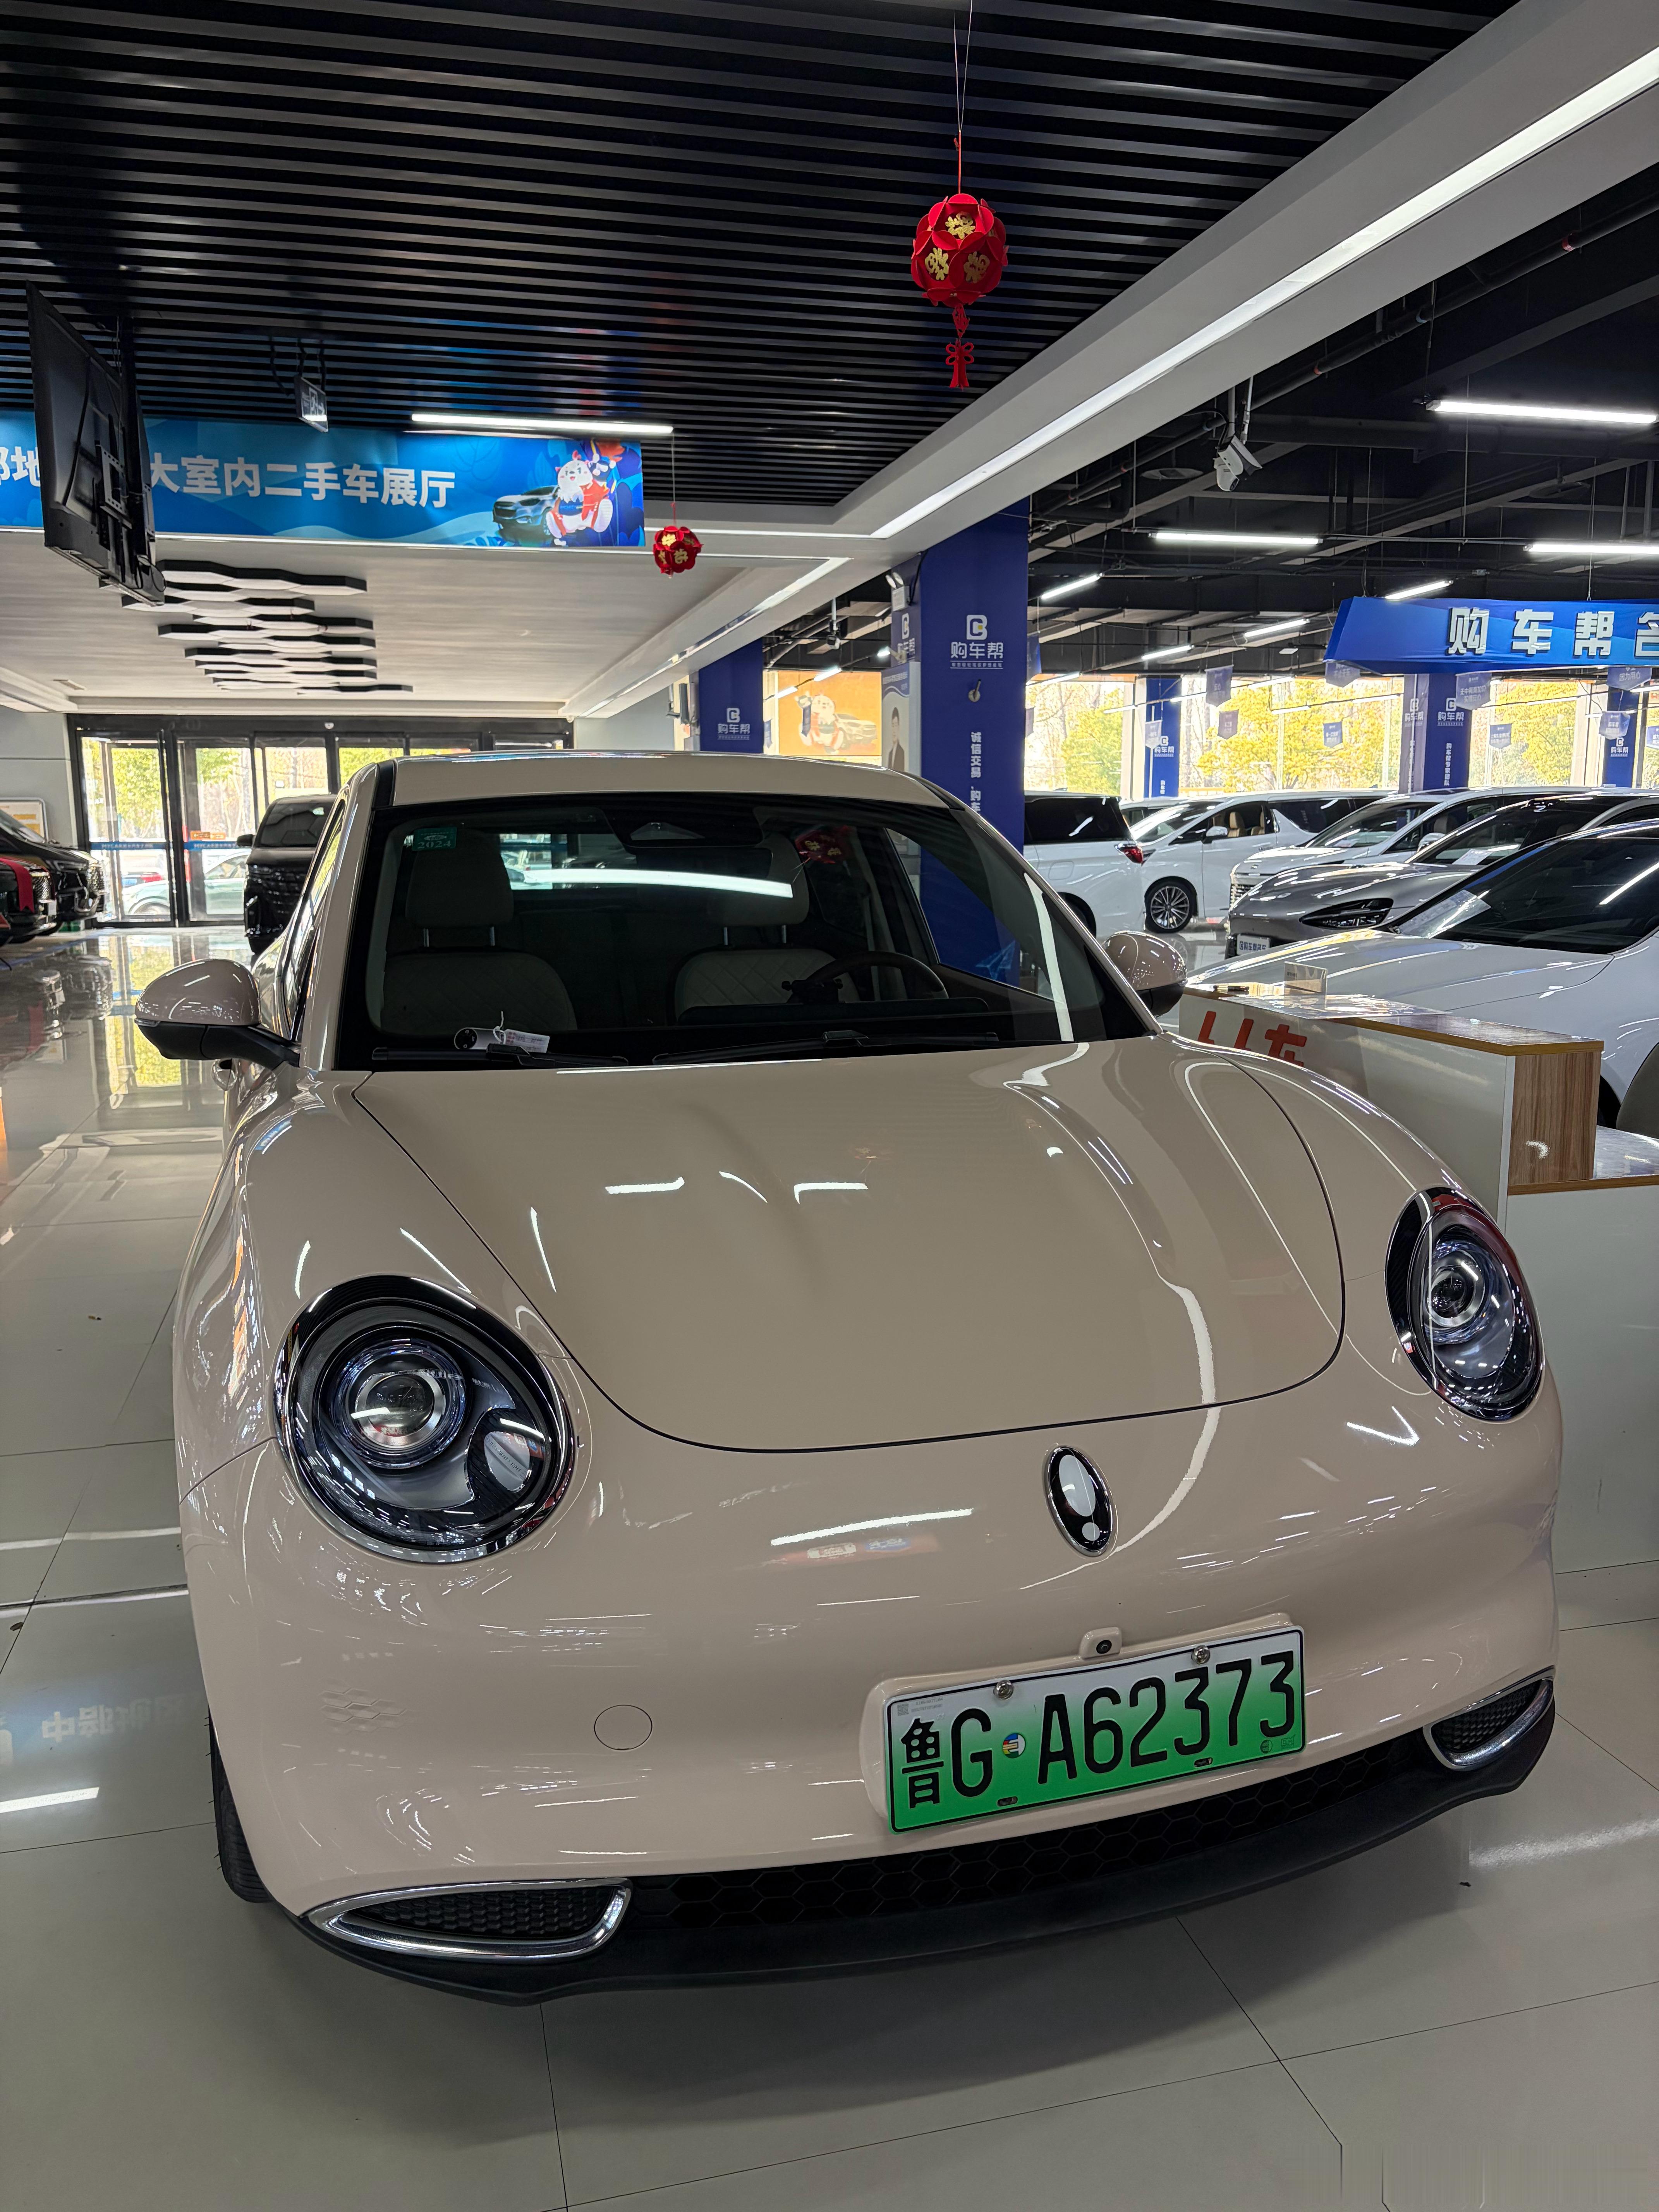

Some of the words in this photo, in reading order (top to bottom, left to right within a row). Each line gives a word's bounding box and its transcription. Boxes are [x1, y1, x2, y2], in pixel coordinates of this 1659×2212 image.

[150, 452, 455, 508] 大室内二手车展厅
[950, 642, 1004, 659] 购车帮
[1437, 711, 1464, 721] 购车帮
[718, 723, 750, 734] 购车帮
[417, 840, 451, 849] 2024
